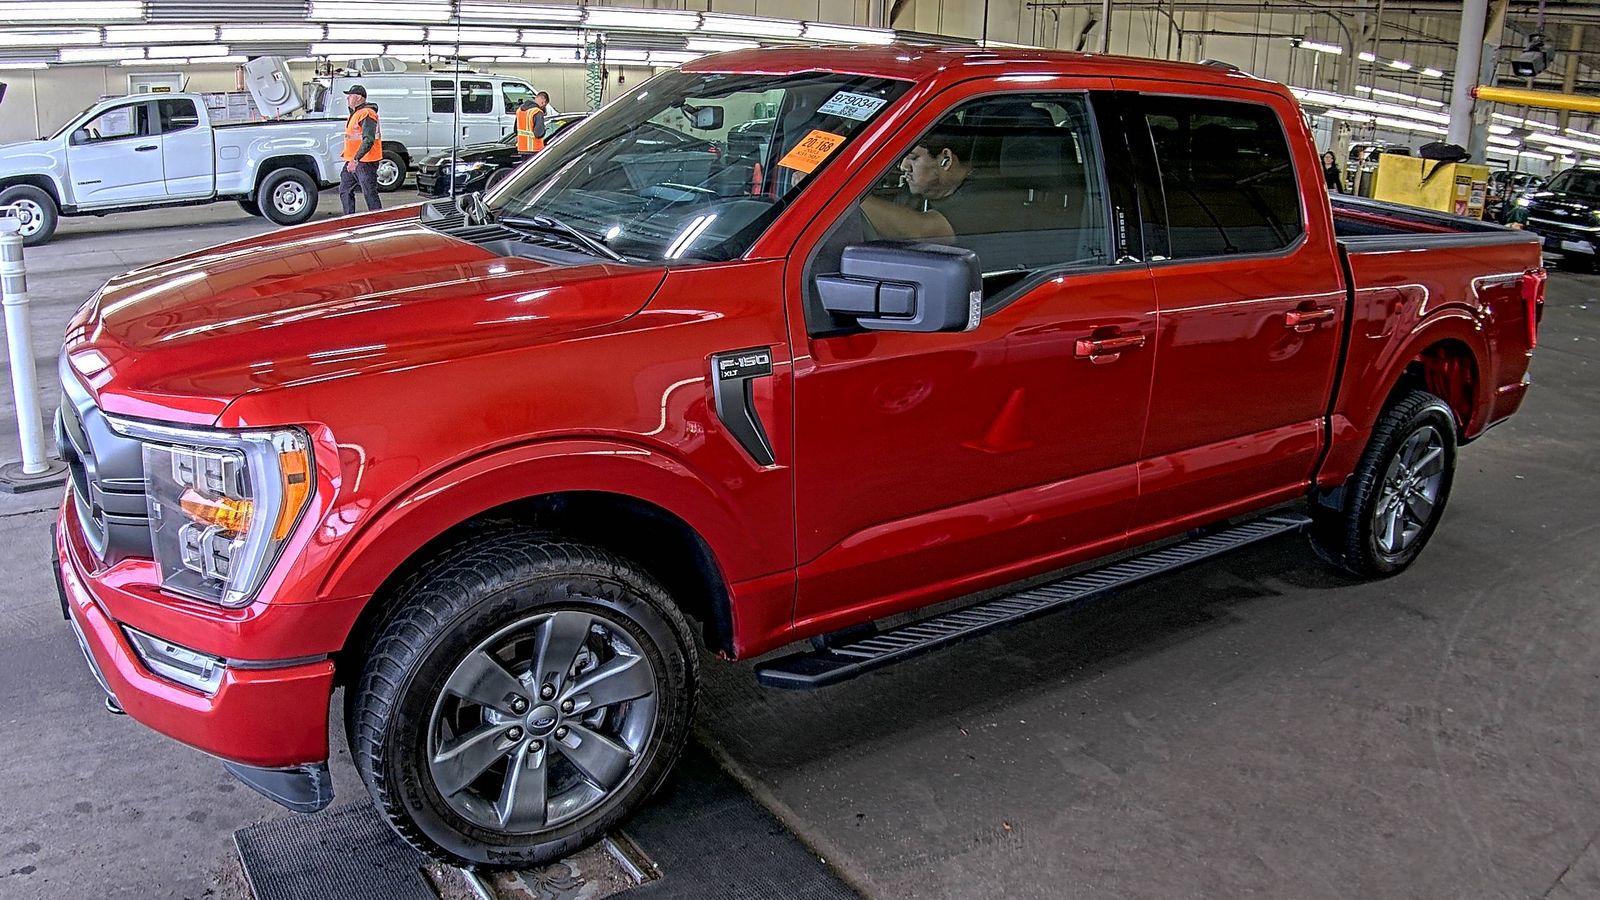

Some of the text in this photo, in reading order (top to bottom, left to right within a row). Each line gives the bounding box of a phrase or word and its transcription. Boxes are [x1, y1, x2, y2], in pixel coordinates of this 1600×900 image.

[832, 94, 883, 110] 9790341
[720, 354, 769, 370] F-150
[723, 370, 738, 378] XLT
